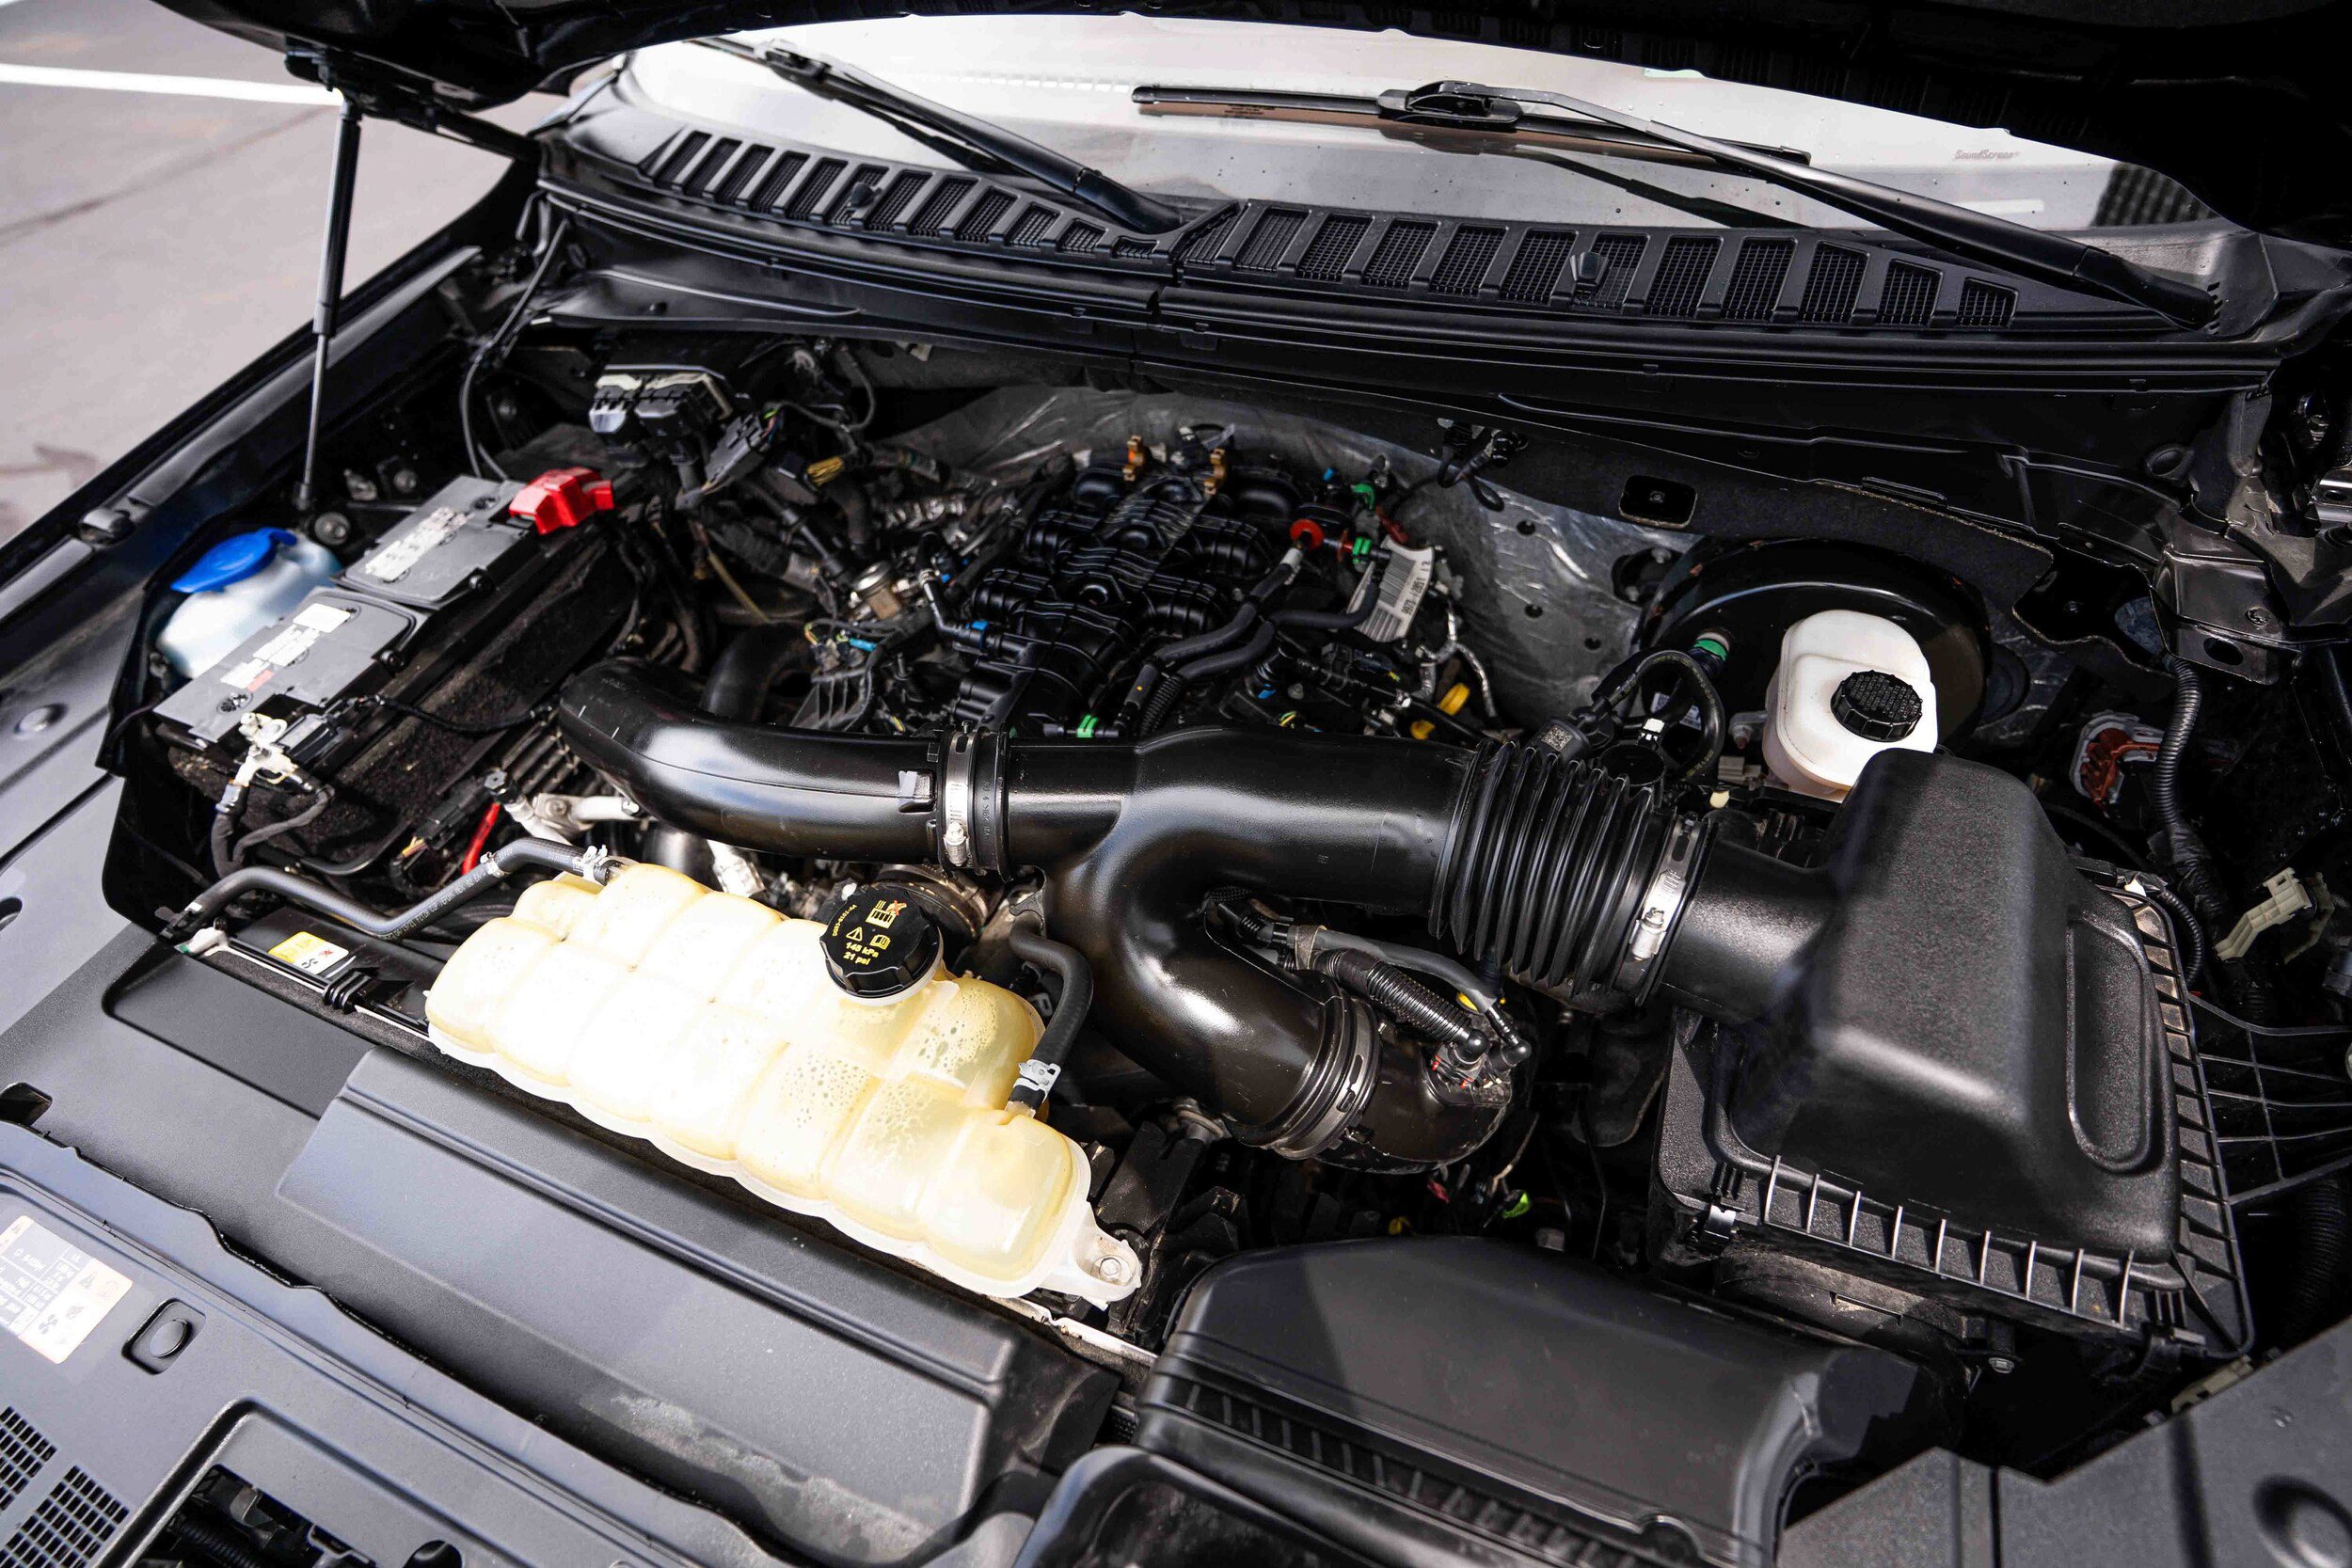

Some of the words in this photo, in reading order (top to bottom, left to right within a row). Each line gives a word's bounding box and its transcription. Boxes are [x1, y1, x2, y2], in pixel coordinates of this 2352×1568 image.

[1955, 150, 2014, 160] SoundScreen
[846, 942, 863, 953] 145
[861, 946, 880, 958] kPa
[843, 951, 856, 961] 21
[854, 957, 871, 966] psi
